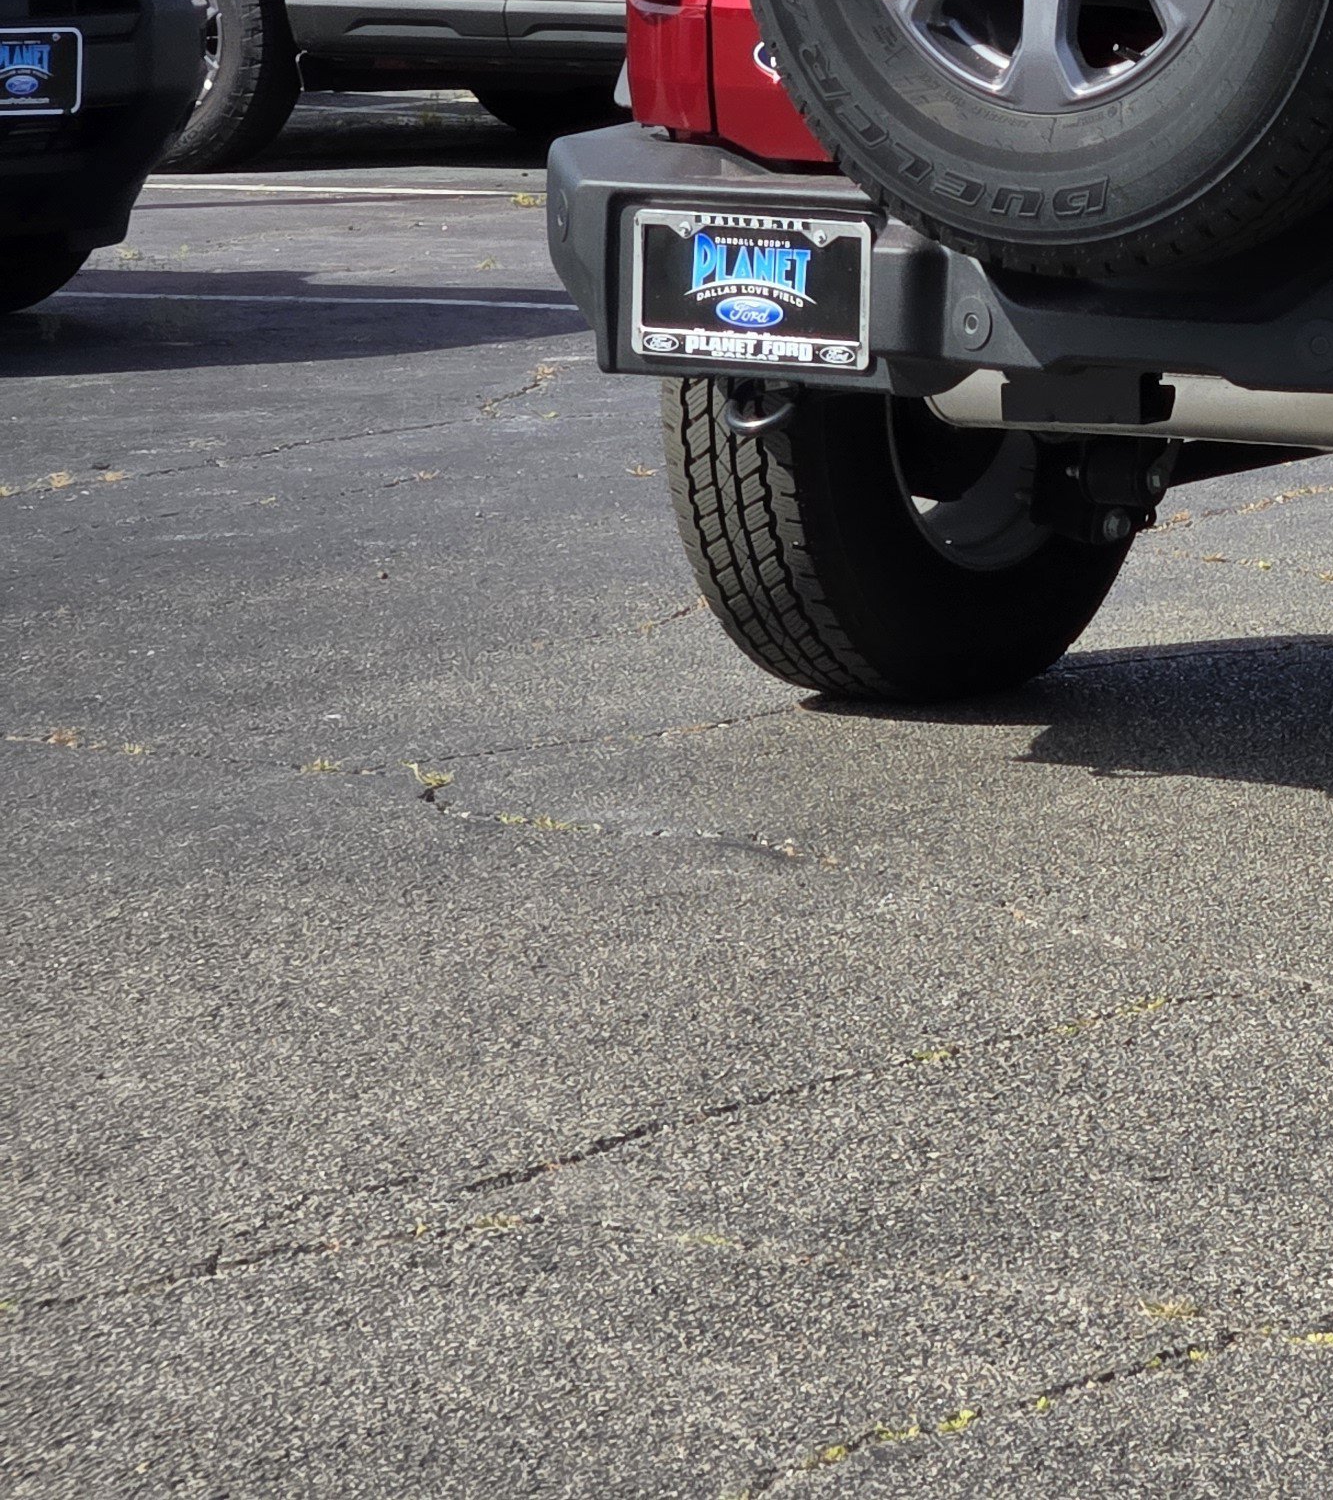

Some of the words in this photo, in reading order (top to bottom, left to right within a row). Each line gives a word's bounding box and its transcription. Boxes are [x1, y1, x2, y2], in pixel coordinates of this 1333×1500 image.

[692, 232, 812, 296] PLANET
[696, 285, 737, 302] DALLAS
[741, 285, 769, 296] LOVE
[773, 289, 804, 309] FIELD
[729, 301, 772, 324] Ford
[685, 334, 757, 355] PLANET
[761, 340, 813, 362] FORD
